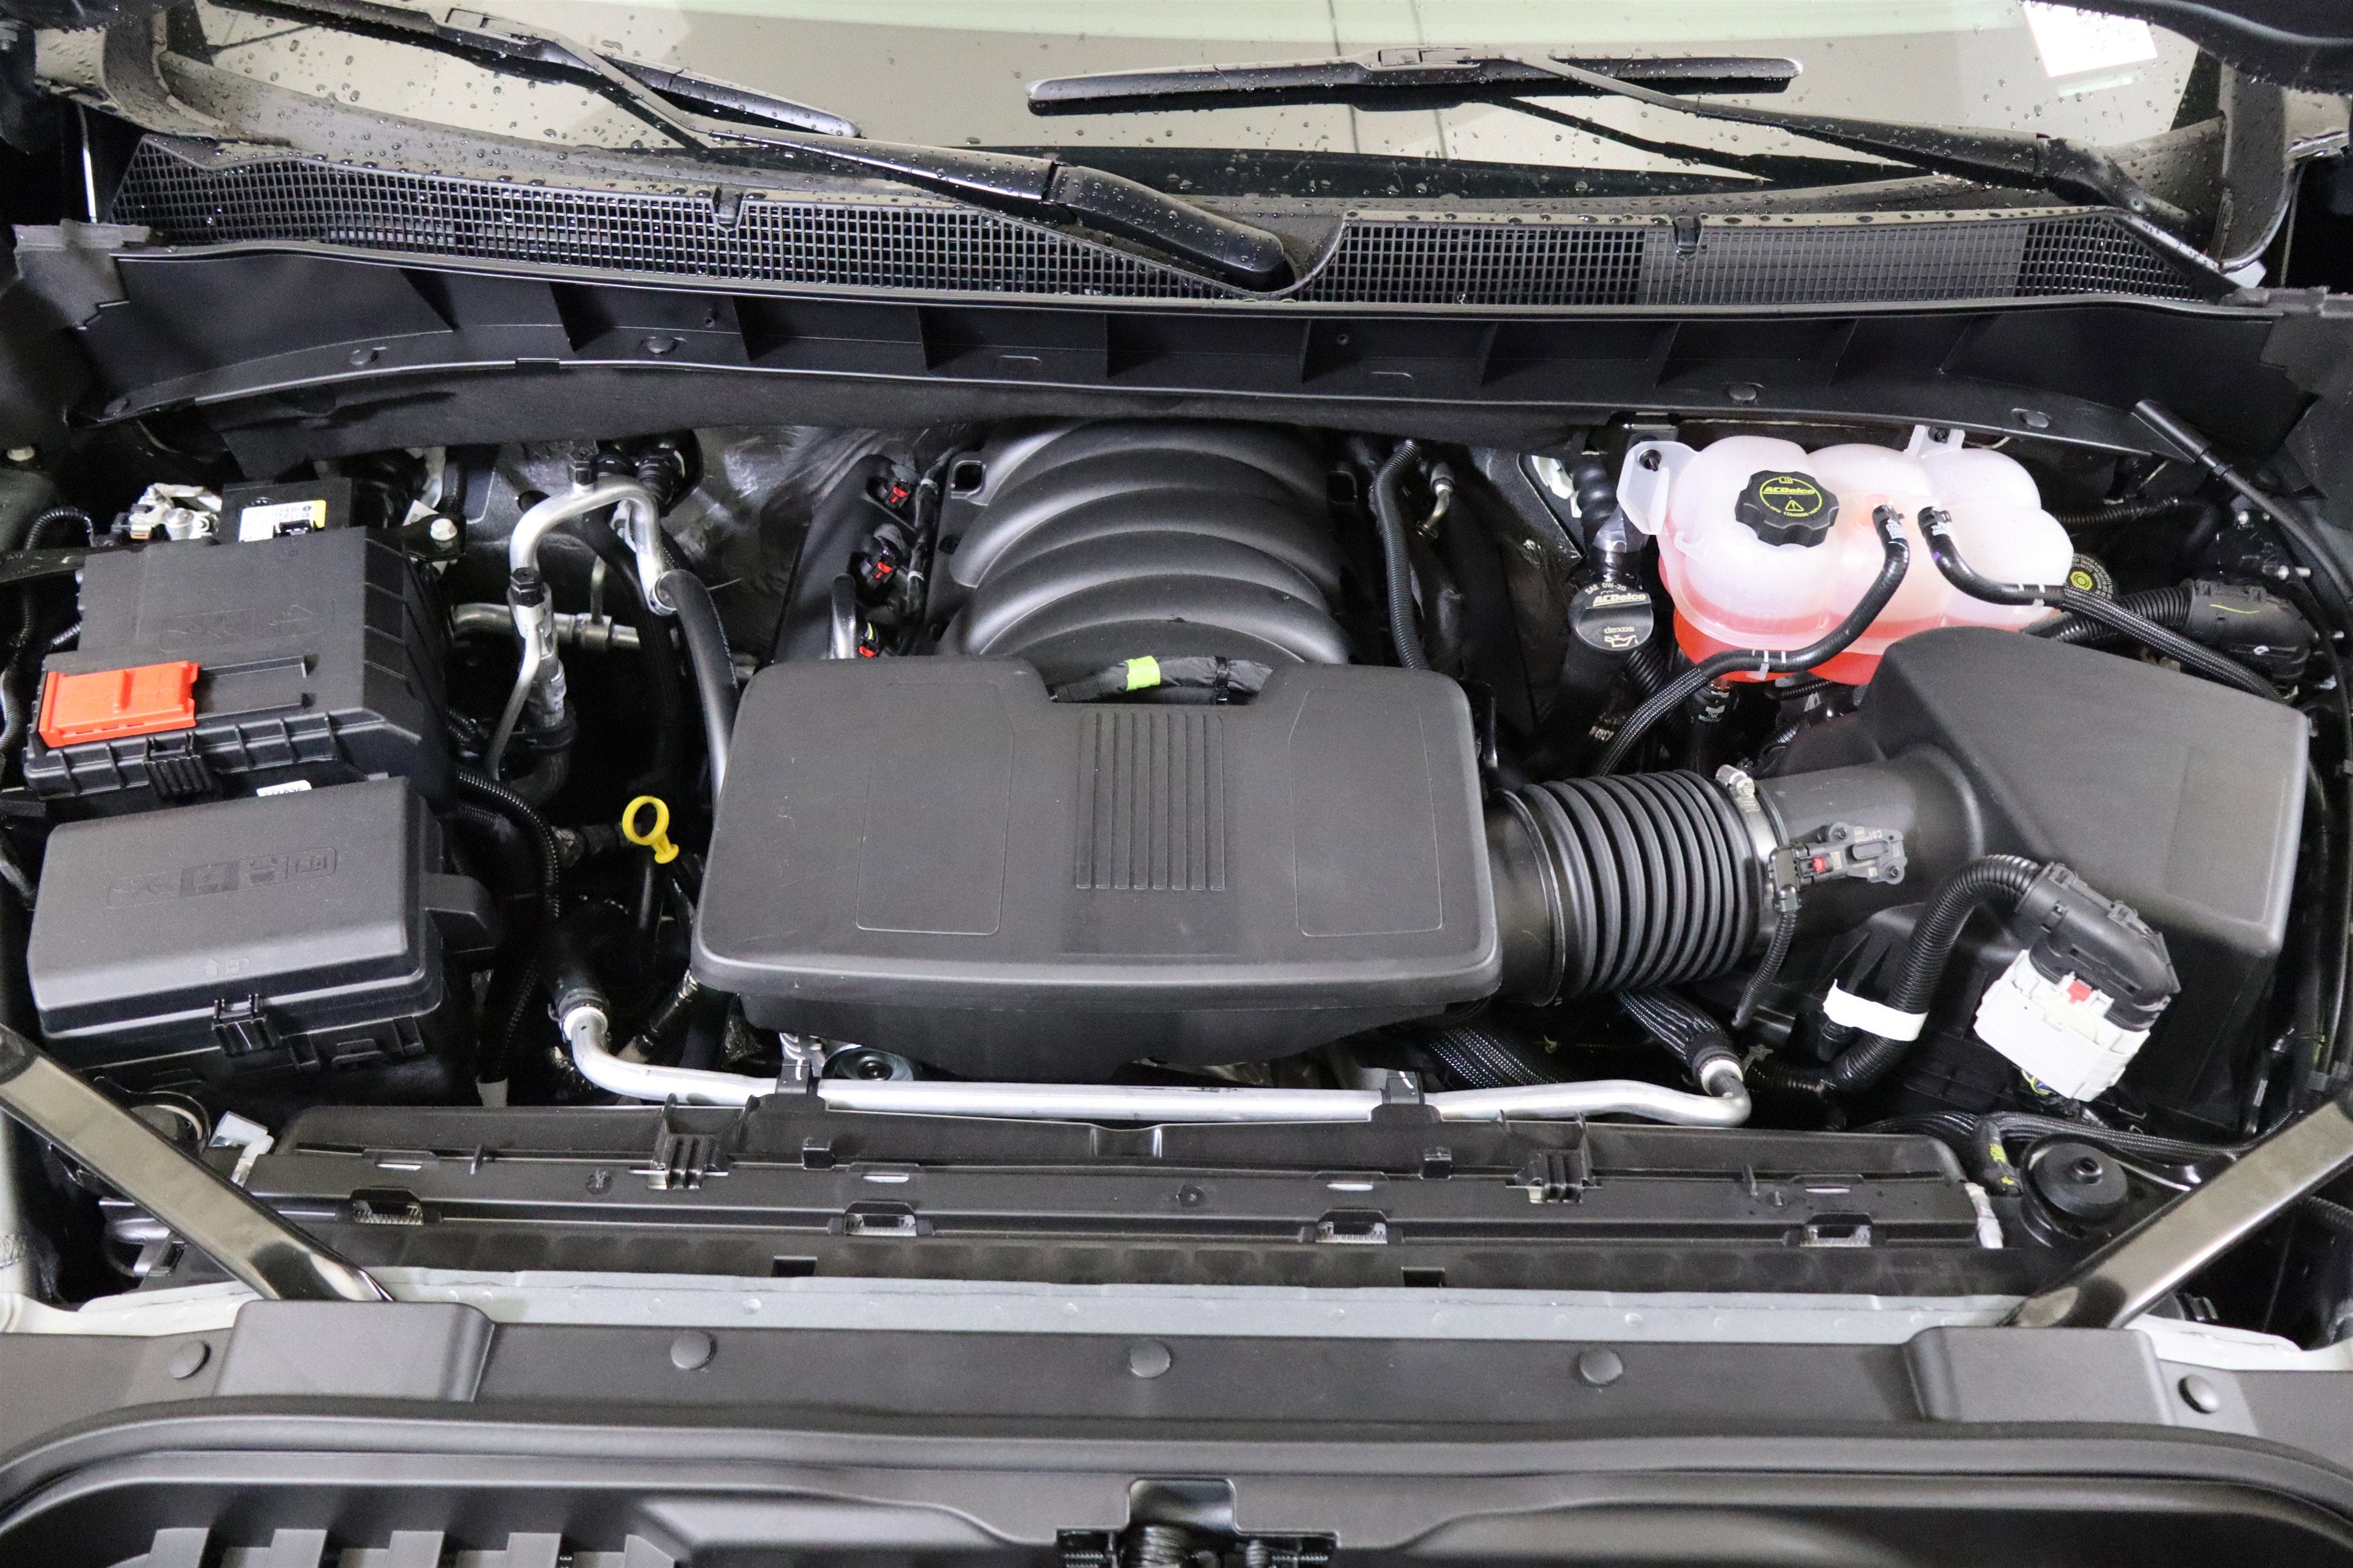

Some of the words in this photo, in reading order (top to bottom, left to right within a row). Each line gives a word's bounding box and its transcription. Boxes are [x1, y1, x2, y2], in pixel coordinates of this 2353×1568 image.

[1763, 486, 1815, 495] ACDelco
[1584, 584, 1600, 595] SAE
[1602, 582, 1627, 592] 0W-20
[1592, 593, 1646, 607] ACDelco
[1604, 626, 1635, 634] dexos
